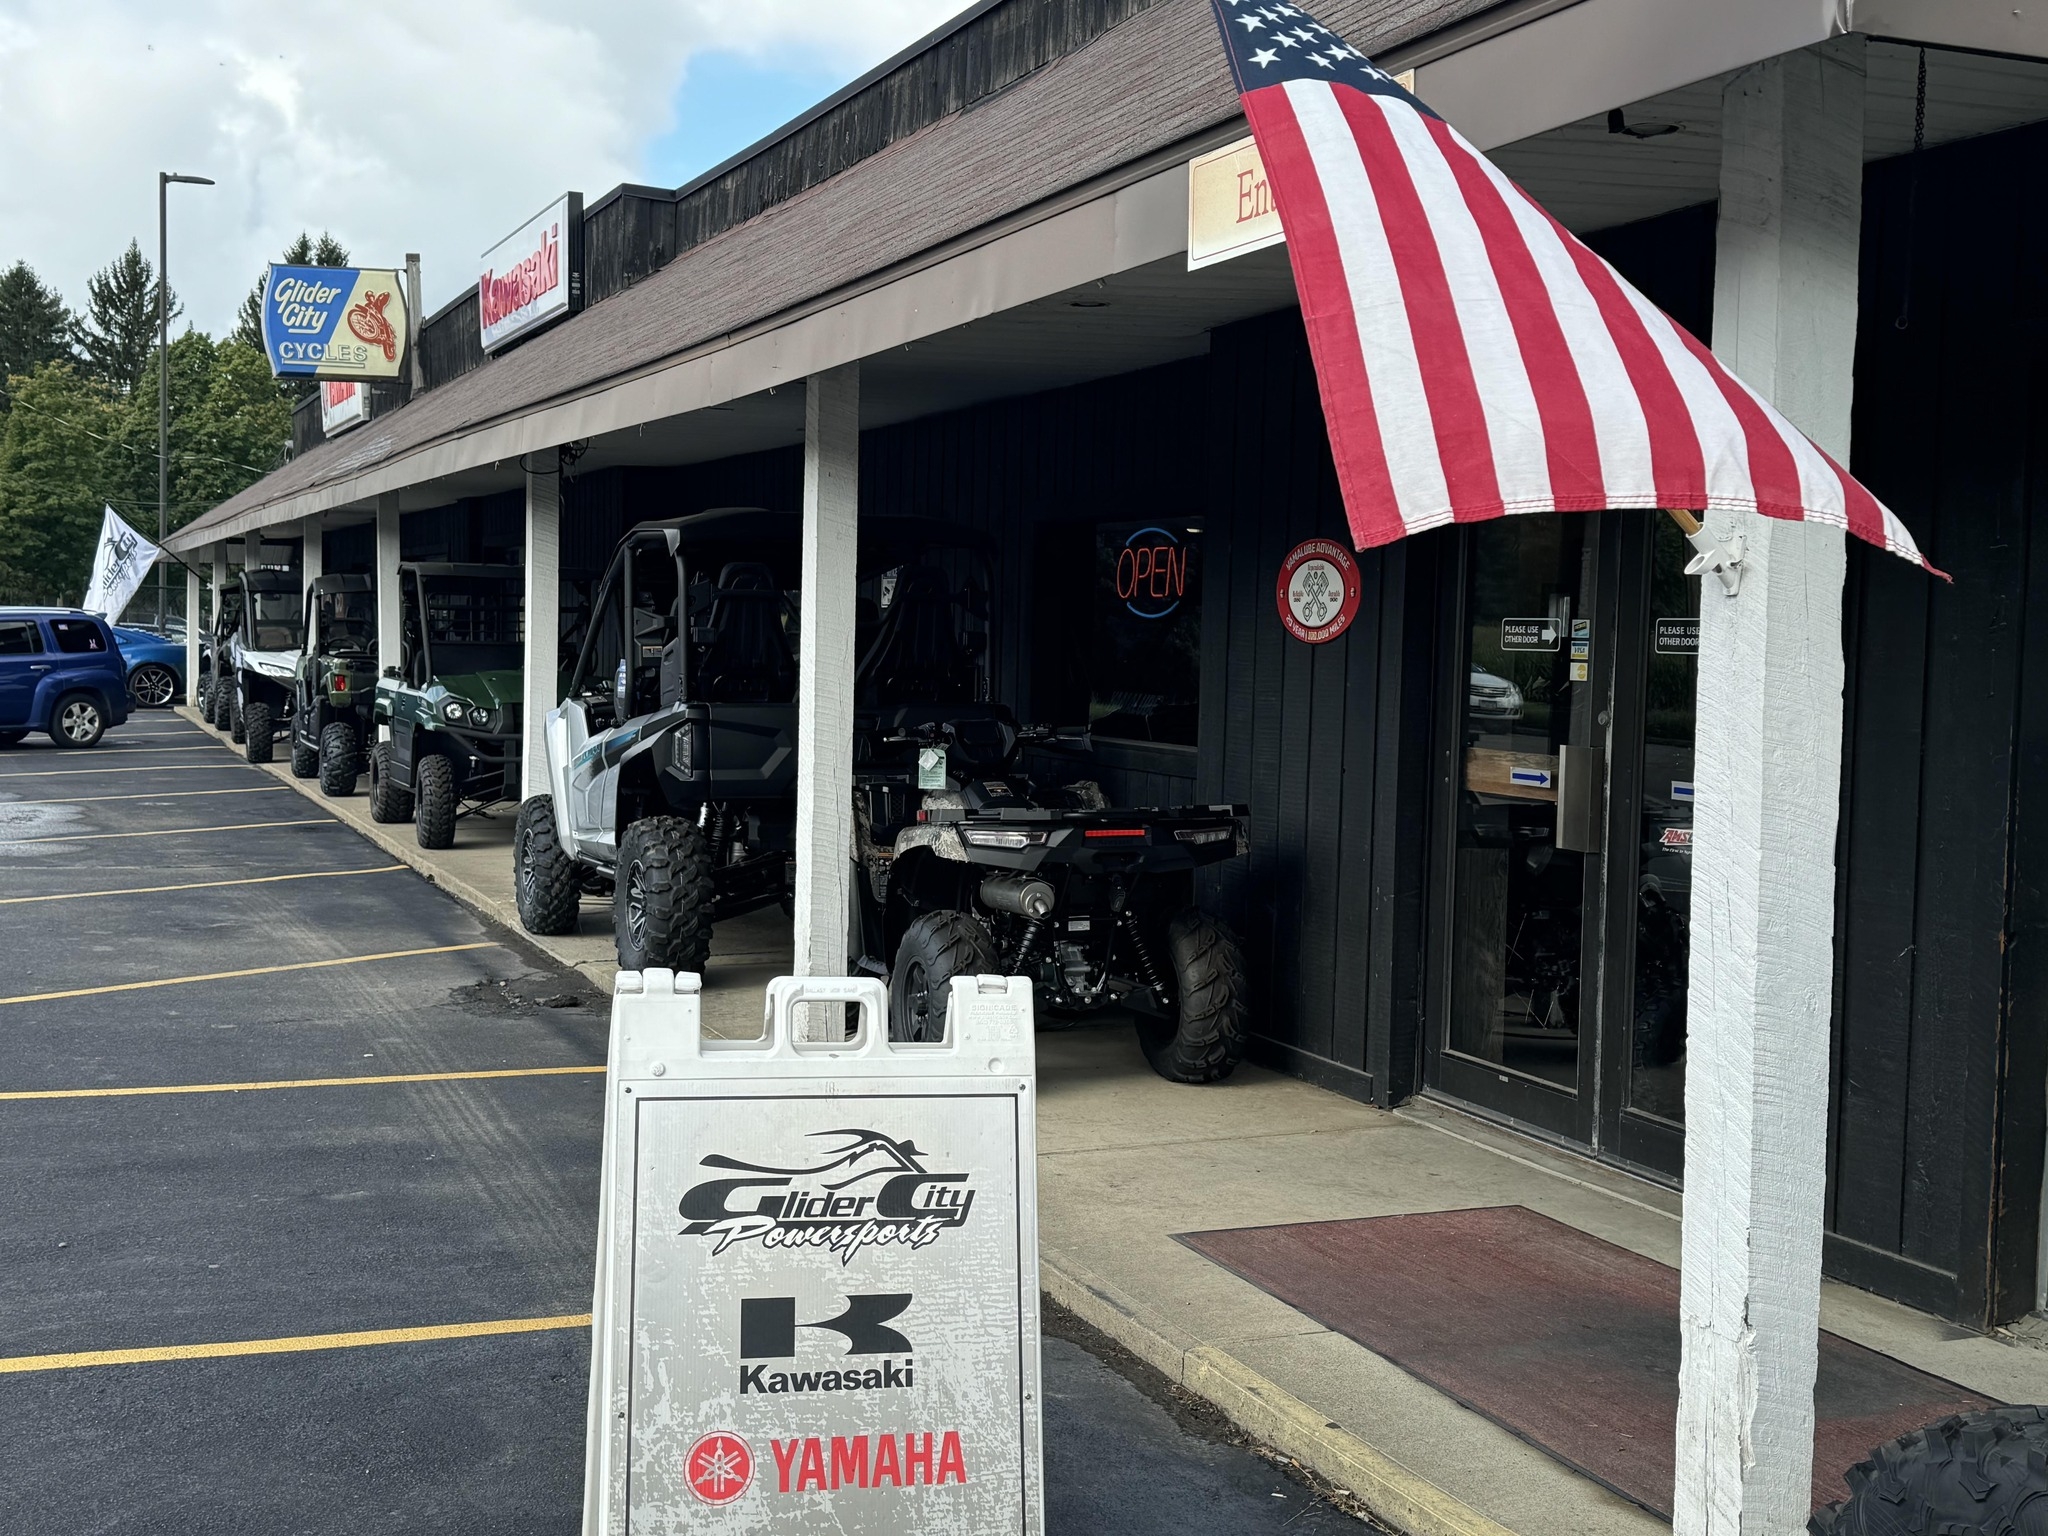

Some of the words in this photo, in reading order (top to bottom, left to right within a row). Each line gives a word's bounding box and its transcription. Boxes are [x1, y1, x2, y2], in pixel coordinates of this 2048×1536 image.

[1236, 168, 1277, 224] En
[480, 222, 559, 329] Kawasaki
[274, 277, 342, 314] Glider
[282, 303, 328, 334] City
[279, 341, 368, 362] CYCLES
[1116, 546, 1187, 599] OPEN
[1316, 542, 1351, 571] ADVANTAGE
[1292, 624, 1306, 639] YEAR
[1329, 613, 1346, 635] MILES
[1504, 625, 1526, 634] PLEASE
[1527, 625, 1540, 634] USE
[1504, 635, 1522, 644] OTHER
[1522, 635, 1539, 644] DOOR
[1659, 626, 1685, 635] PLEASE
[1686, 626, 1700, 635] USE
[1659, 637, 1681, 646] OTHER
[678, 1176, 876, 1221] Glider
[876, 1172, 977, 1228] City
[702, 1214, 953, 1267] Powersports
[740, 1358, 914, 1395] Kawasaki
[770, 1430, 967, 1494] YAMAHA
